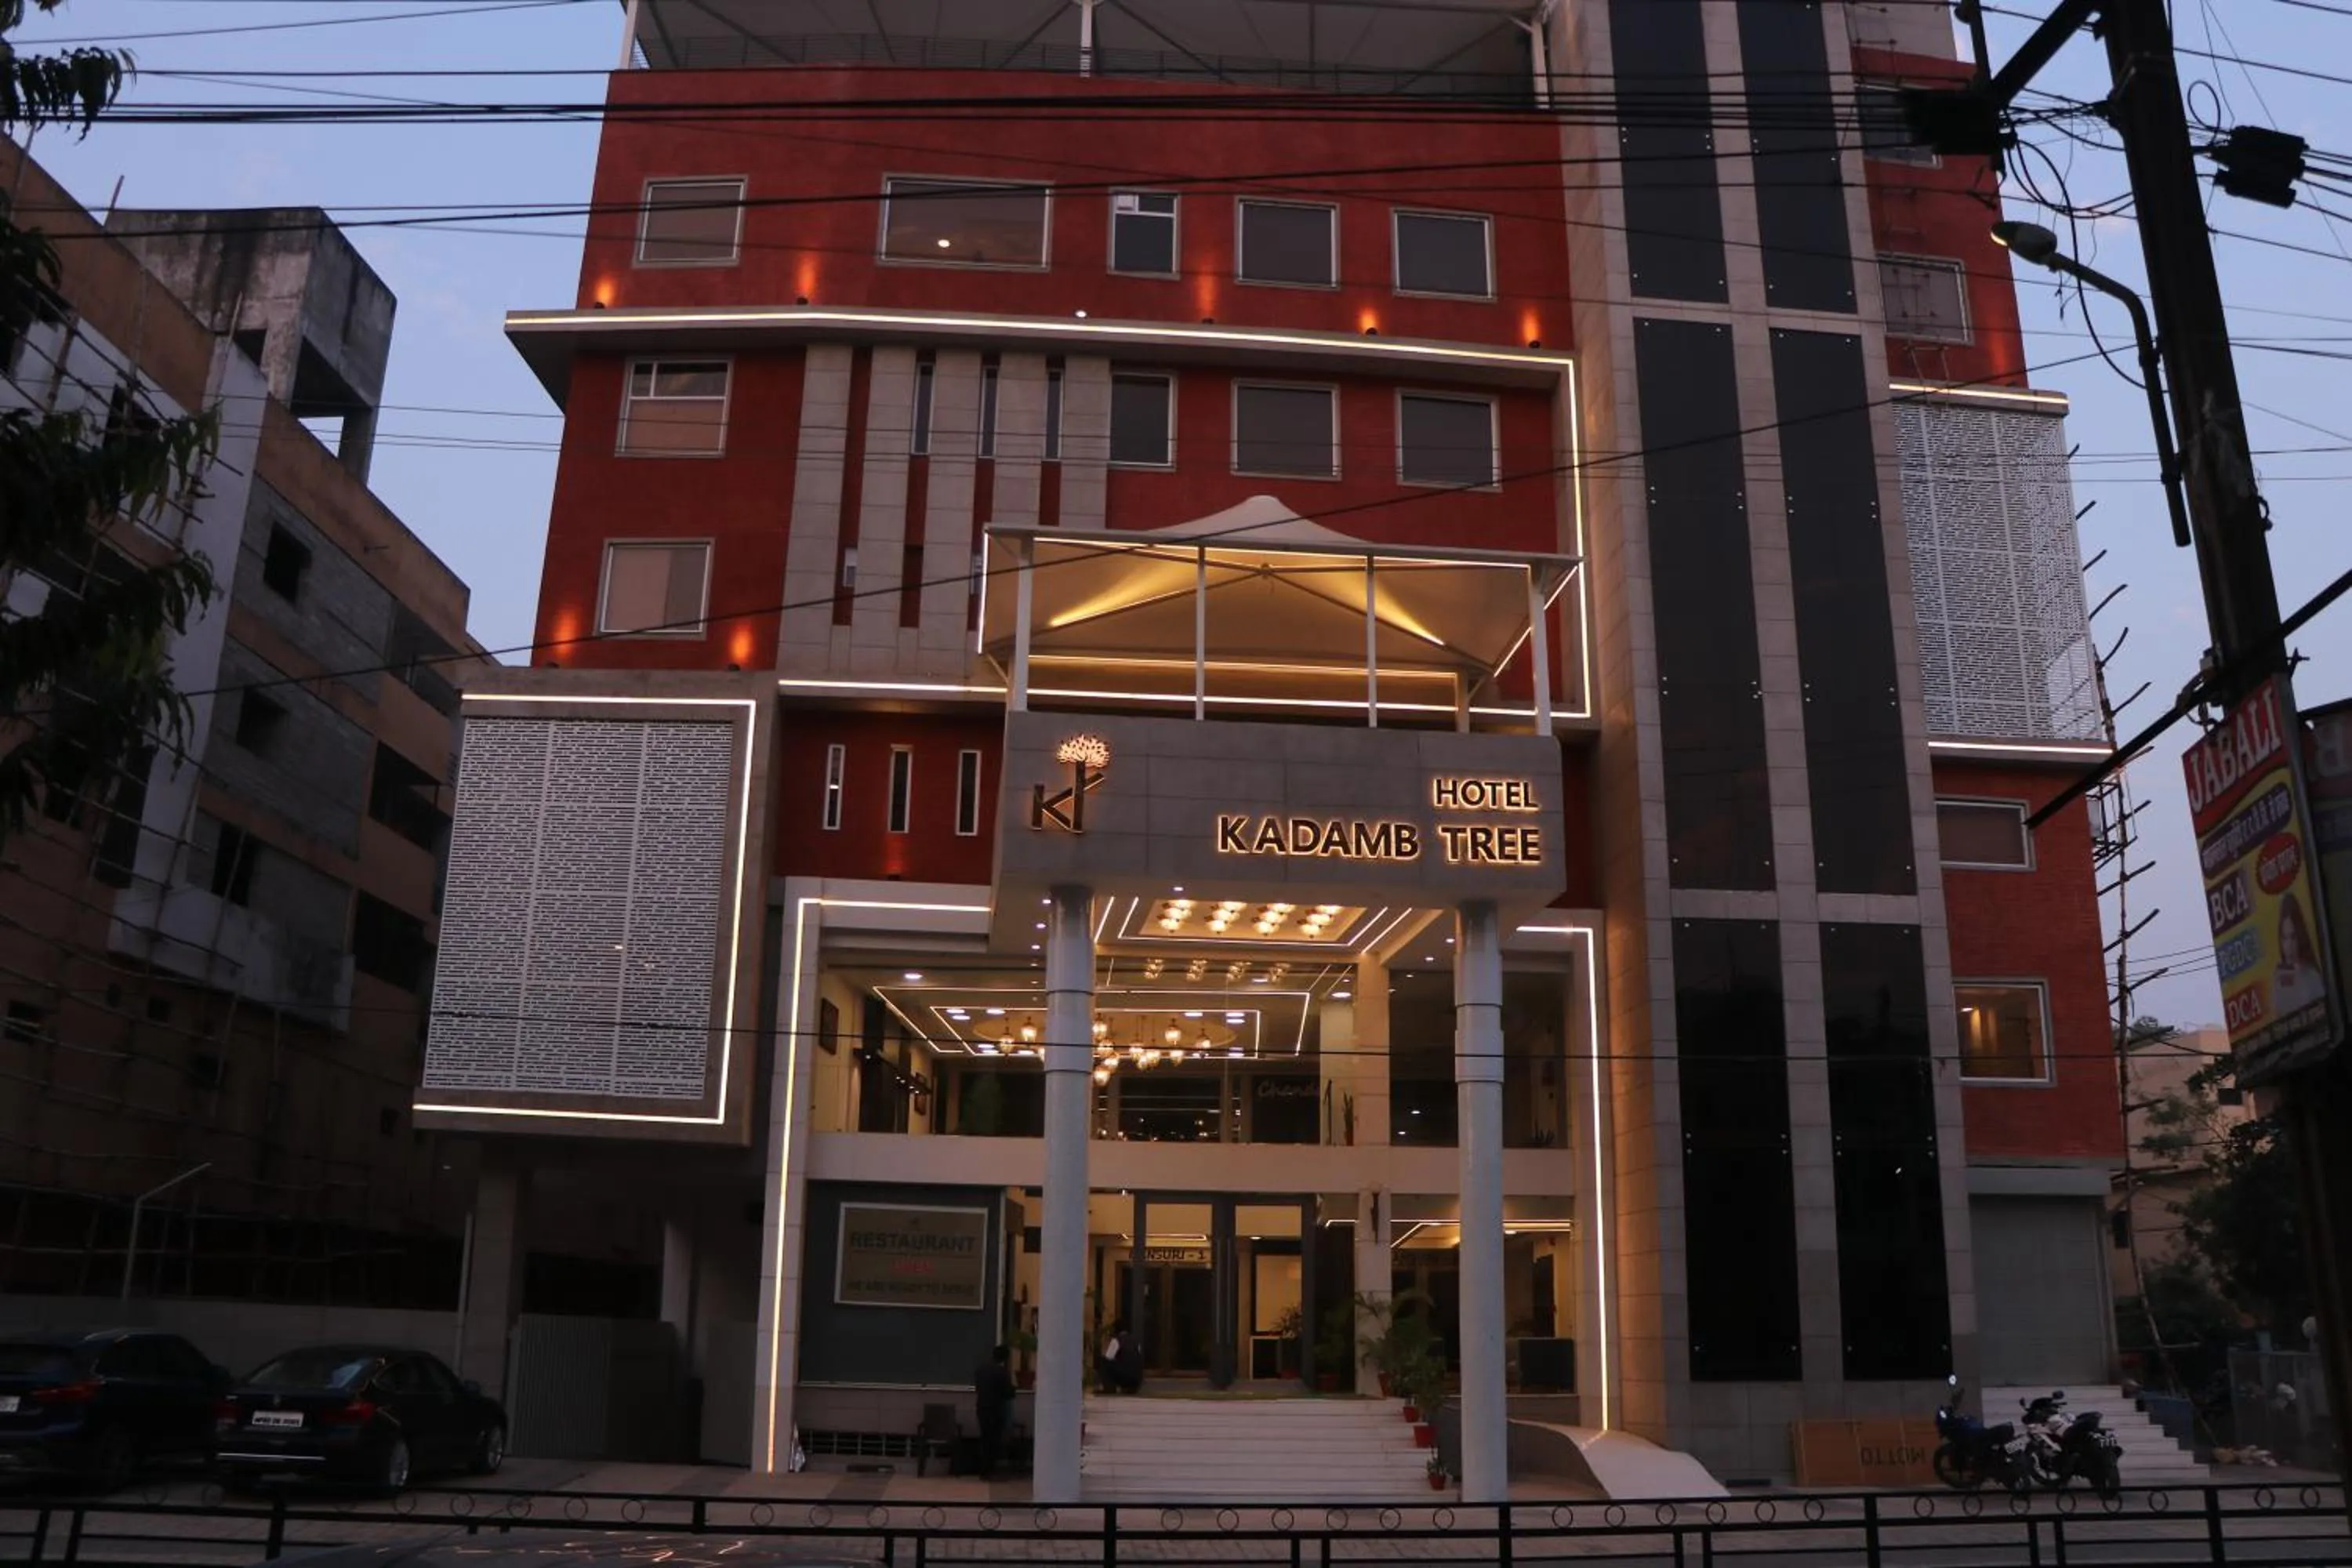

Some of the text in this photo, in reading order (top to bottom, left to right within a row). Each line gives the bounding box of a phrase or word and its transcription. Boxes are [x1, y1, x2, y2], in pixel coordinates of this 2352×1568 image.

[2190, 687, 2281, 813] JABALI
[1433, 778, 1540, 811] HOTEL
[1218, 815, 1542, 863] KADAMB TREE
[2210, 877, 2249, 930] BCA
[2227, 989, 2262, 1030] DCA
[851, 1232, 976, 1252] RESTAURANT
